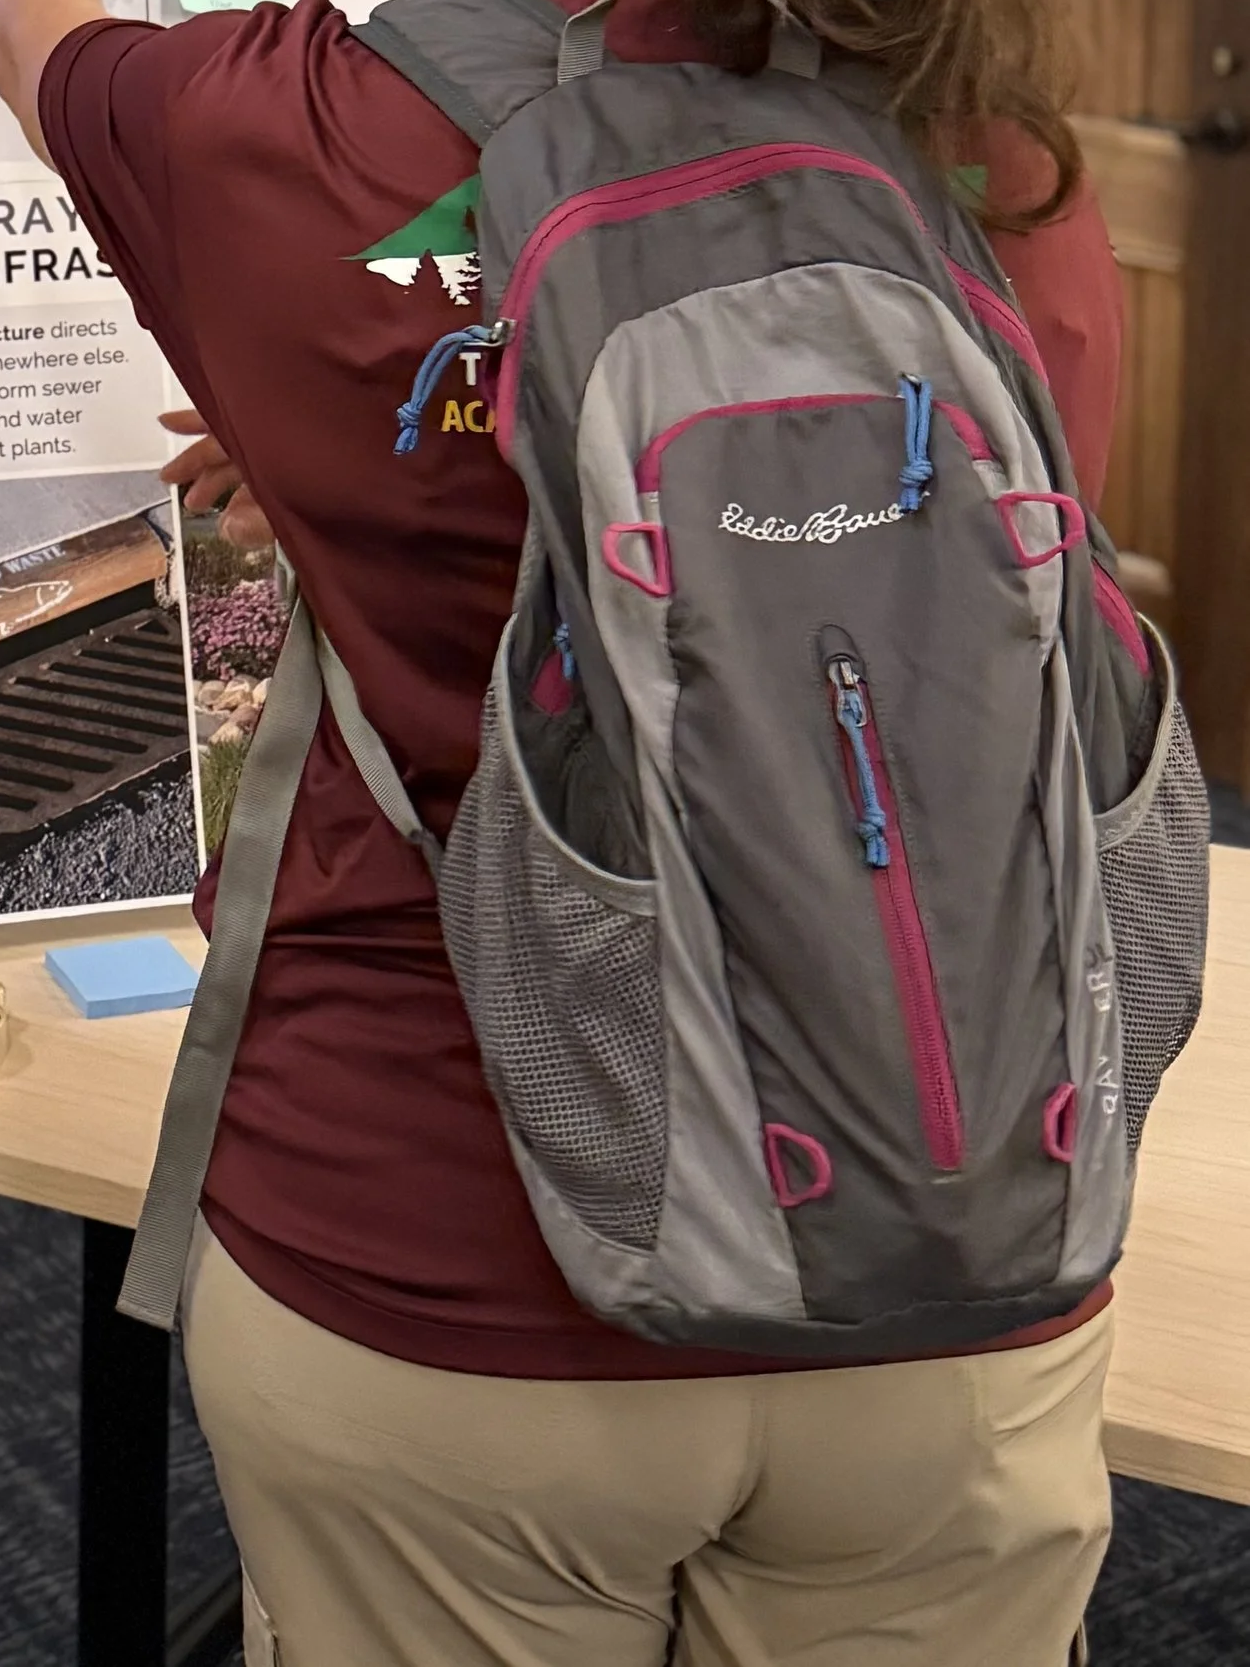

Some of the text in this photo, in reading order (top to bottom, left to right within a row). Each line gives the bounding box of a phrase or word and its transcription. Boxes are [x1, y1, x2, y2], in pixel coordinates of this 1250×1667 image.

[50, 319, 118, 339] directs
[83, 347, 129, 365] else.
[42, 379, 103, 398] sewer
[26, 408, 83, 428] water
[11, 437, 77, 460] plants.
[718, 492, 931, 544] Eddie Baue
[3, 543, 67, 574] WASTE
